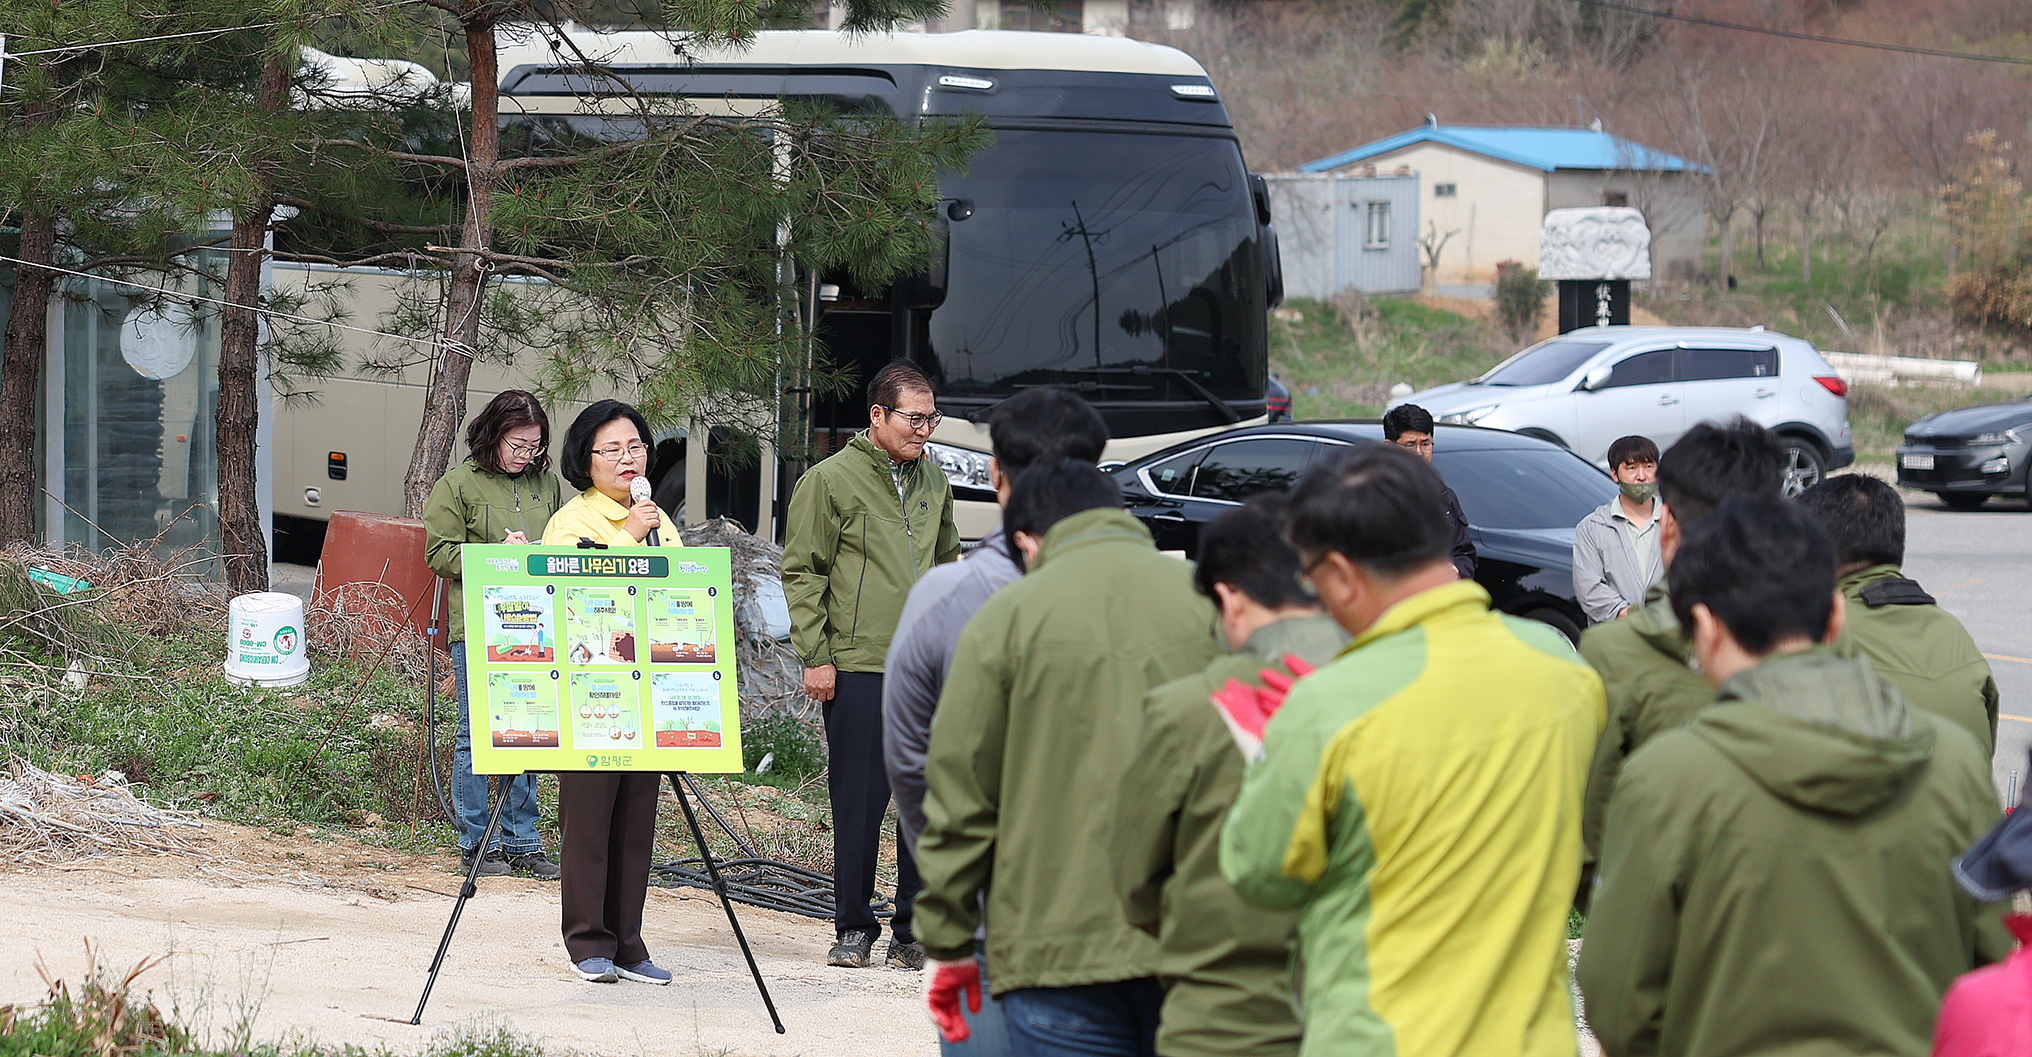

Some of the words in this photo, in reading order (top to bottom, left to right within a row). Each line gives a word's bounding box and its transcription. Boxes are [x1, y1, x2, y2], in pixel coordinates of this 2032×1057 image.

[546, 556, 580, 574] 올바른
[581, 557, 626, 574] 나무심기
[627, 558, 650, 575] 요령
[600, 755, 632, 767] 함평군
